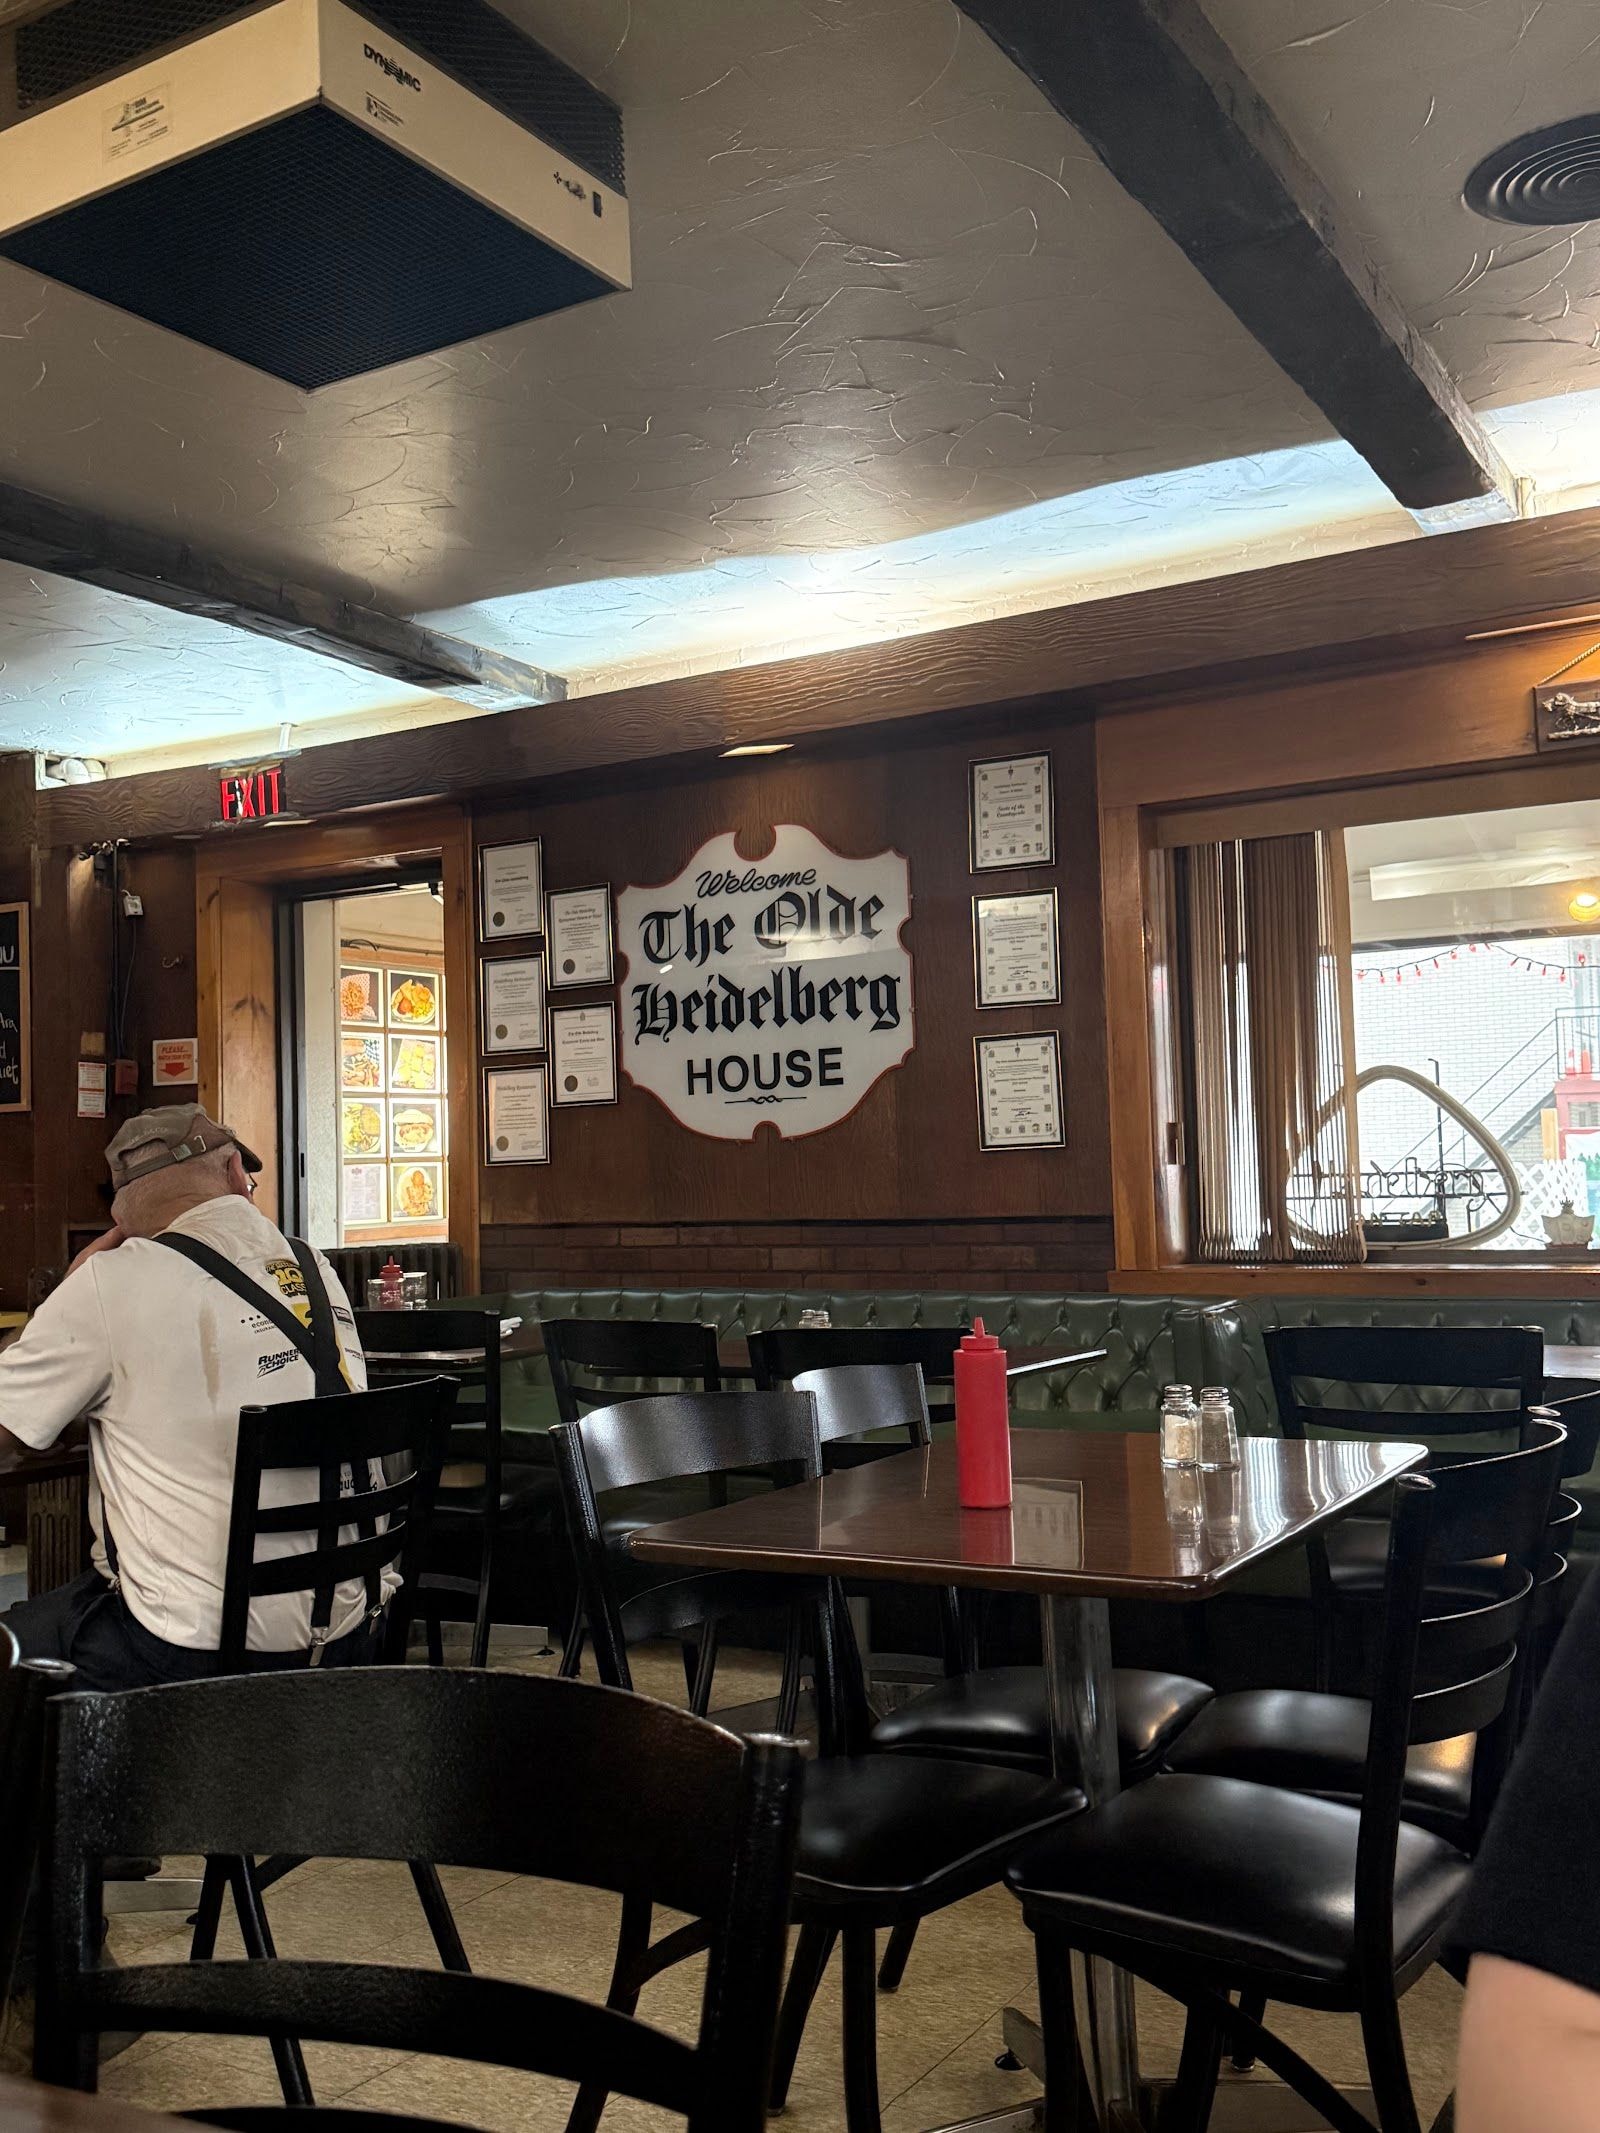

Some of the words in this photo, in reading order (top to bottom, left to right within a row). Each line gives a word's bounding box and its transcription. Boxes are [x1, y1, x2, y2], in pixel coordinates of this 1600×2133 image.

[221, 768, 282, 822] EXIT
[696, 868, 817, 898] Welcome
[638, 902, 736, 968] The
[754, 884, 885, 950] Olde
[0, 945, 15, 964] U
[631, 965, 901, 1045] Heidelberg
[686, 1047, 844, 1095] HOUSE
[265, 1355, 299, 1369] CHOICE
